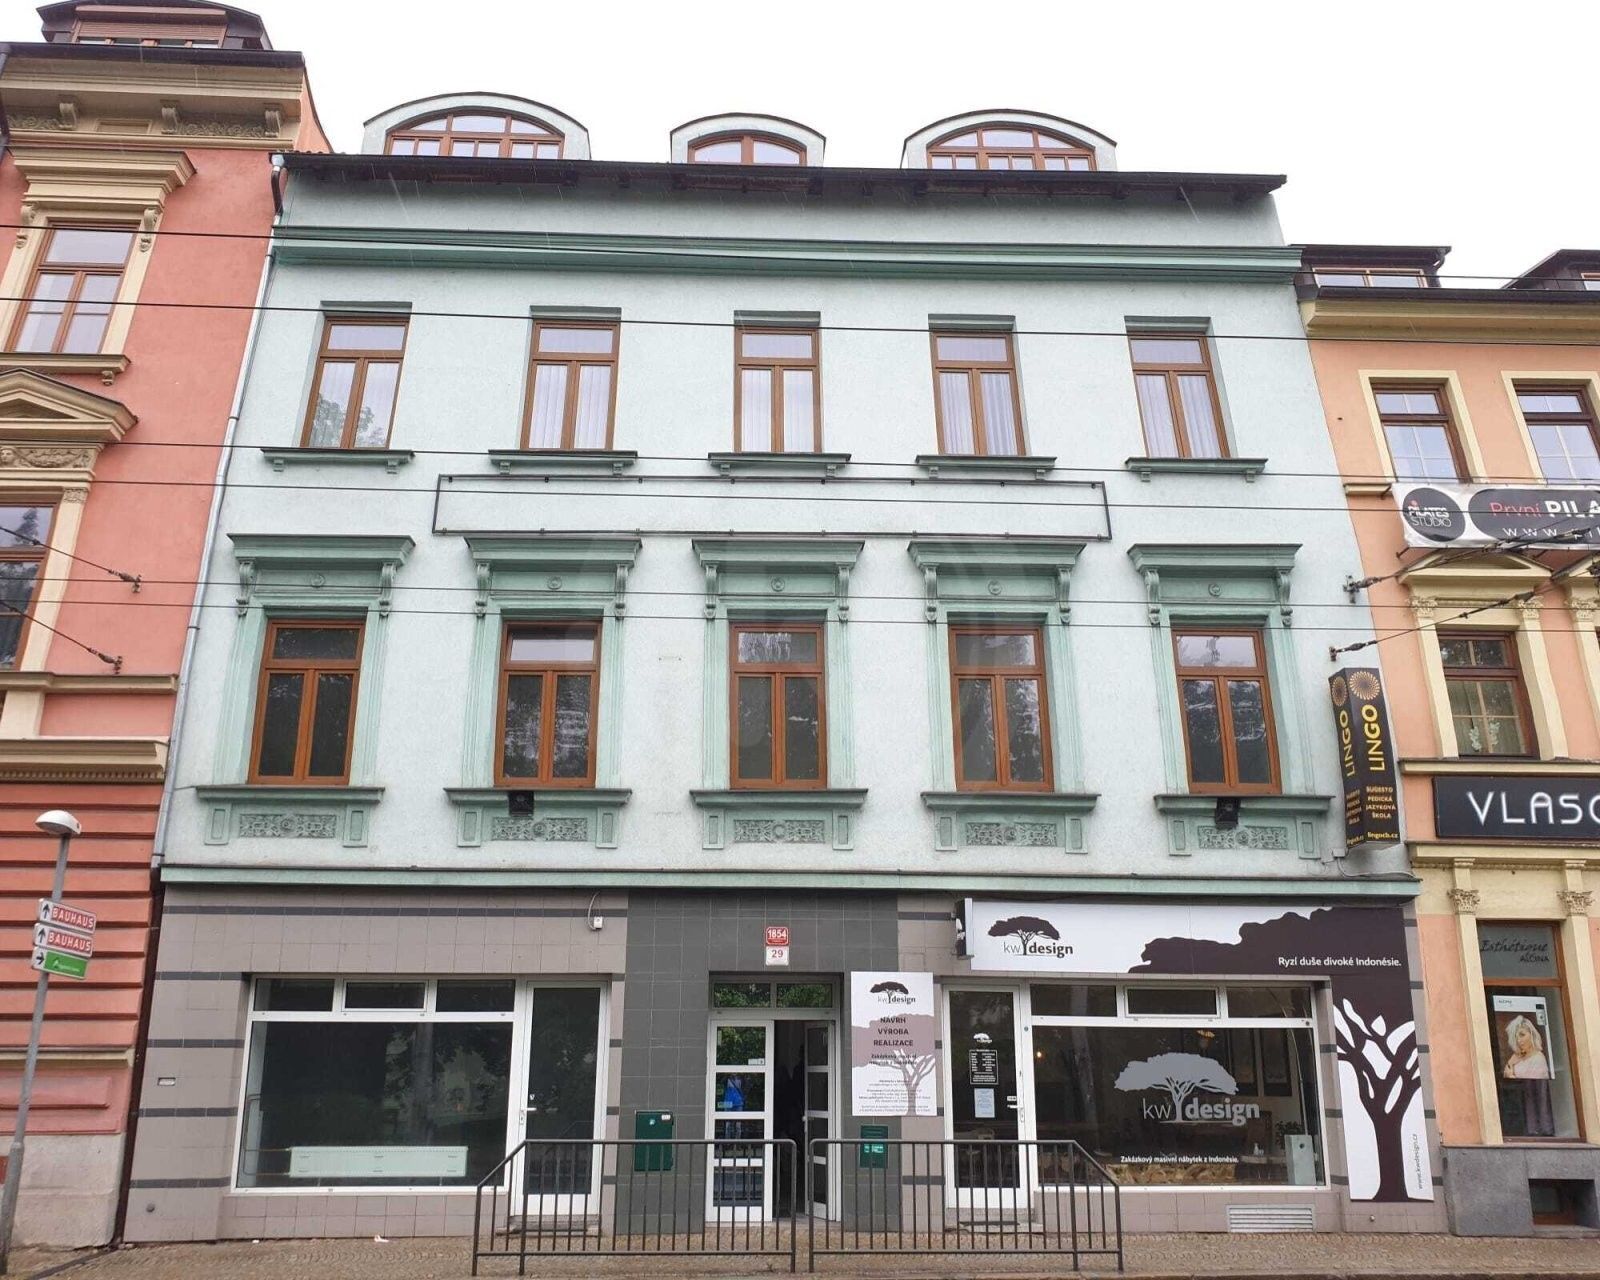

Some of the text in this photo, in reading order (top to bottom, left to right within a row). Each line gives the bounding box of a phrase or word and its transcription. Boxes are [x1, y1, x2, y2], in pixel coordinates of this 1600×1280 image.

[1411, 516, 1452, 528] STUDIO
[1361, 704, 1386, 772] LINGO
[1340, 709, 1355, 777] LINGO
[1365, 803, 1396, 811] JAZYKOVÁ
[1372, 811, 1392, 819] ŠKOLA
[52, 907, 94, 928] BAUHAUS
[768, 929, 787, 938] 1854
[48, 932, 91, 951] BAUHAUS
[771, 949, 784, 958] 29
[1278, 957, 1402, 968] Ryzí duše divoké Indonésie.
[880, 1015, 906, 1024] NÁVRH
[877, 1027, 909, 1035] VÝROBA
[873, 1039, 914, 1047] REALIZACE
[1120, 1155, 1152, 1164] Zakázkový
[1154, 1155, 1177, 1163] masivní
[1178, 1155, 1202, 1164] nábytek
